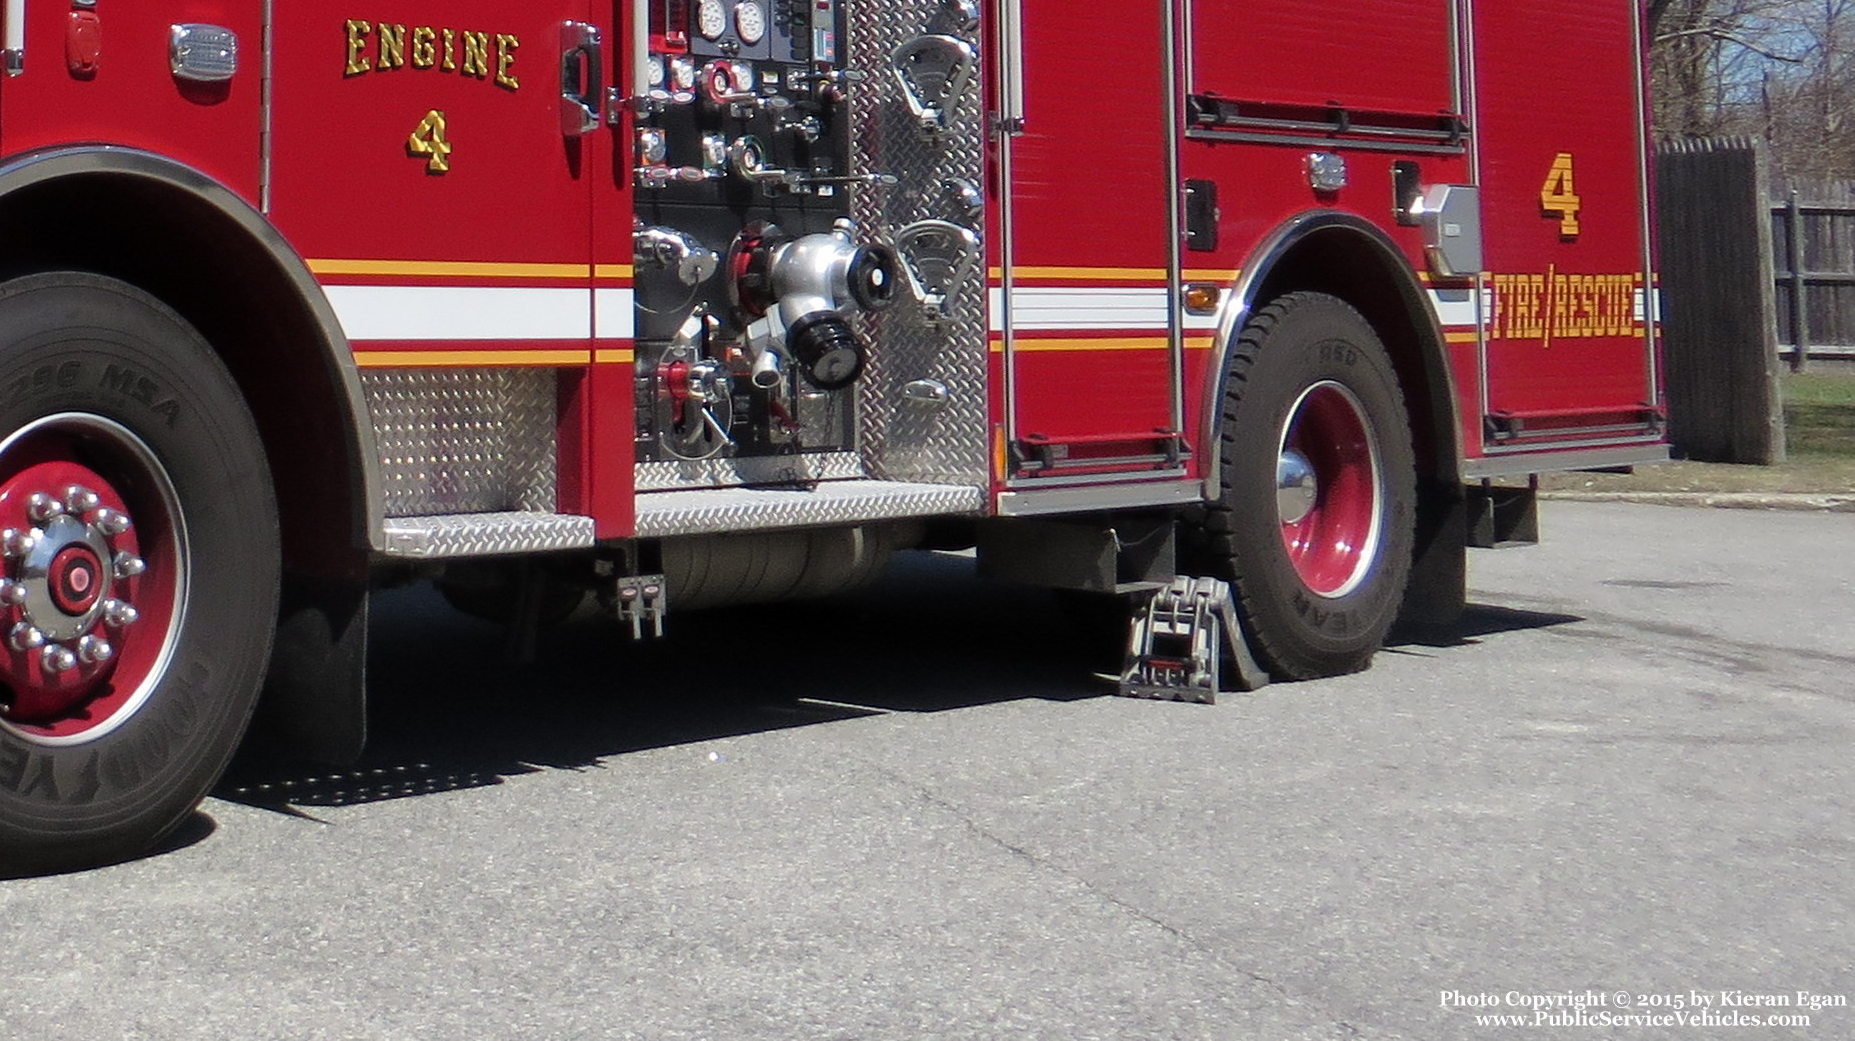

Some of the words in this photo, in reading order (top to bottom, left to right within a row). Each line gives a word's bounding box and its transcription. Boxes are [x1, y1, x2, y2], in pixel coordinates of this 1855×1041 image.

[344, 19, 520, 90] ENGINE
[407, 109, 452, 175] 4
[1541, 152, 1580, 240] 4
[1491, 263, 1633, 348] FIRE/RESCUE
